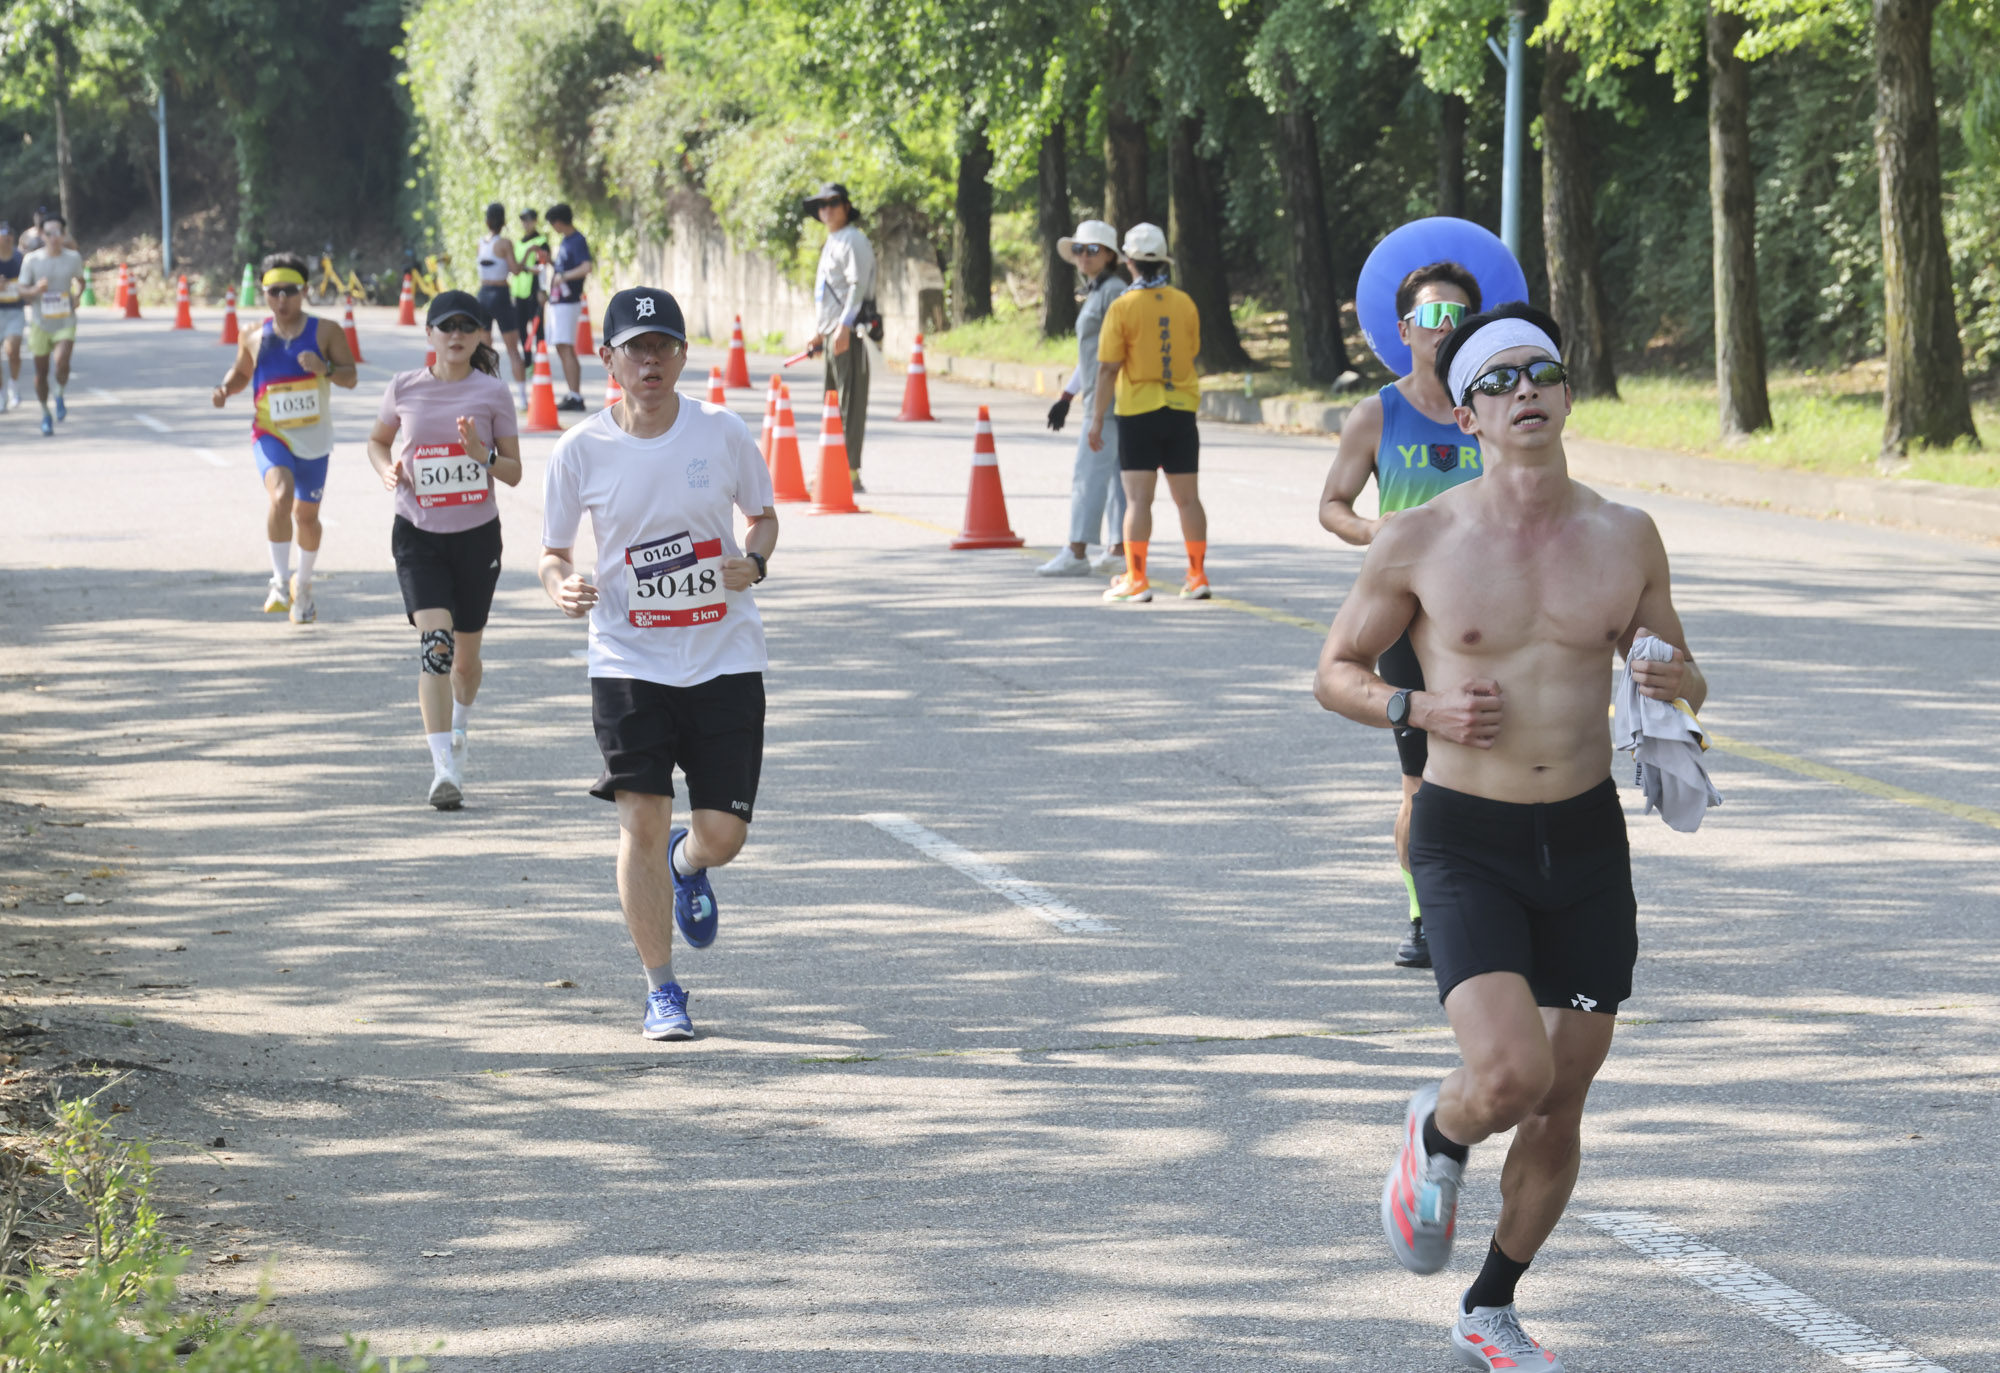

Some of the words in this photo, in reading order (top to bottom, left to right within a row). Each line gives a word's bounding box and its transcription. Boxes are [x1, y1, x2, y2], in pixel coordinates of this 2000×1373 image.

[635, 297, 656, 320] D
[275, 395, 315, 413] 1035
[1459, 446, 1484, 469] R
[420, 462, 480, 486] 5043
[643, 543, 682, 562] 0140
[636, 568, 717, 599] 5048
[692, 612, 699, 622] 5
[700, 610, 719, 620] km
